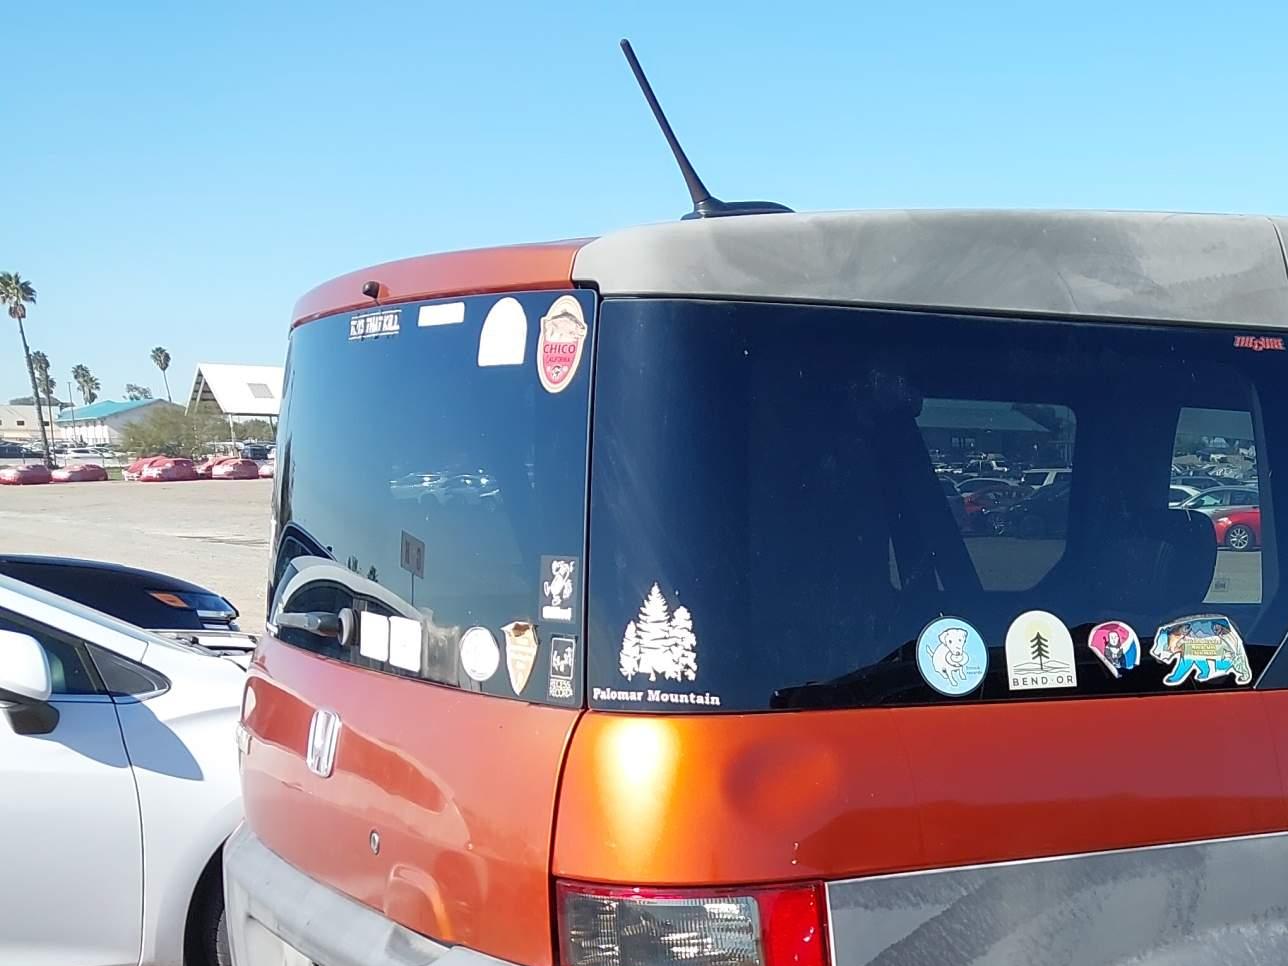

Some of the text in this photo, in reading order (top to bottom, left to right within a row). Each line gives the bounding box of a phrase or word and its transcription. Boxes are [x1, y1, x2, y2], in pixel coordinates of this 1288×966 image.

[544, 344, 576, 354] CHICO
[593, 687, 721, 706] Palomar Mountain
